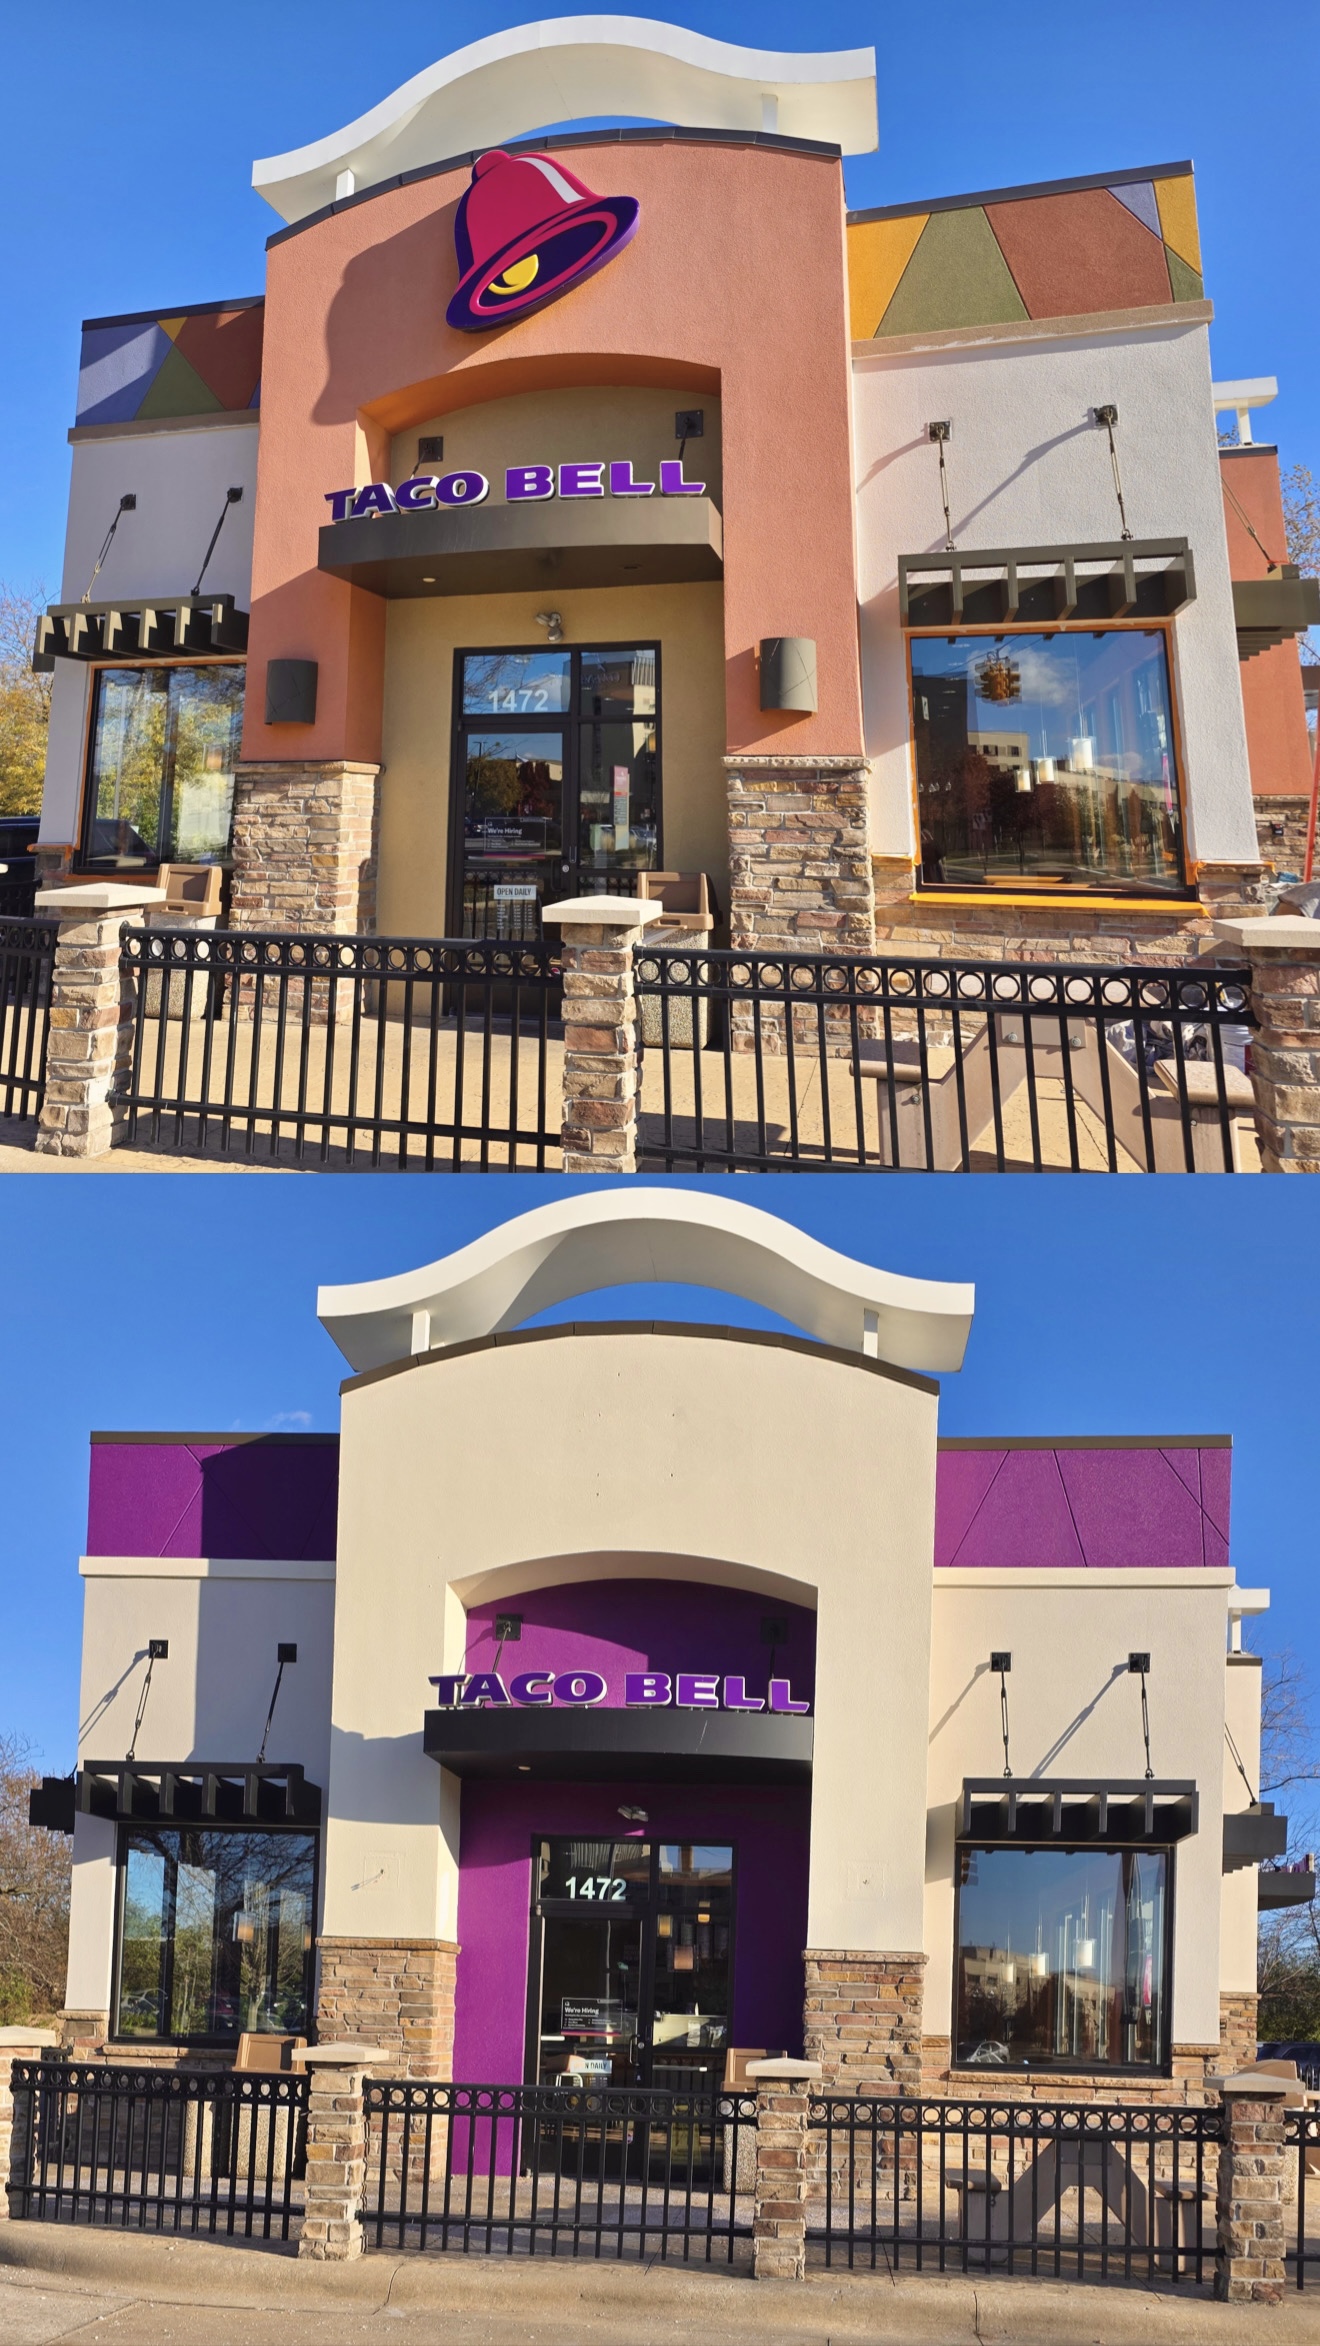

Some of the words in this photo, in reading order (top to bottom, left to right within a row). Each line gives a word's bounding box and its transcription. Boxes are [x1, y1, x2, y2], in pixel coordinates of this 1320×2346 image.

[324, 470, 490, 523] TACO
[505, 460, 707, 501] BELL
[488, 689, 549, 712] 1472
[497, 888, 513, 896] OPEN
[514, 888, 532, 896] DAILY
[428, 1670, 607, 1708] TACO
[625, 1672, 810, 1714] BELL
[565, 1876, 627, 1900] 1472
[581, 2007, 600, 2015] Hiring
[590, 2062, 608, 2070] DAILY
